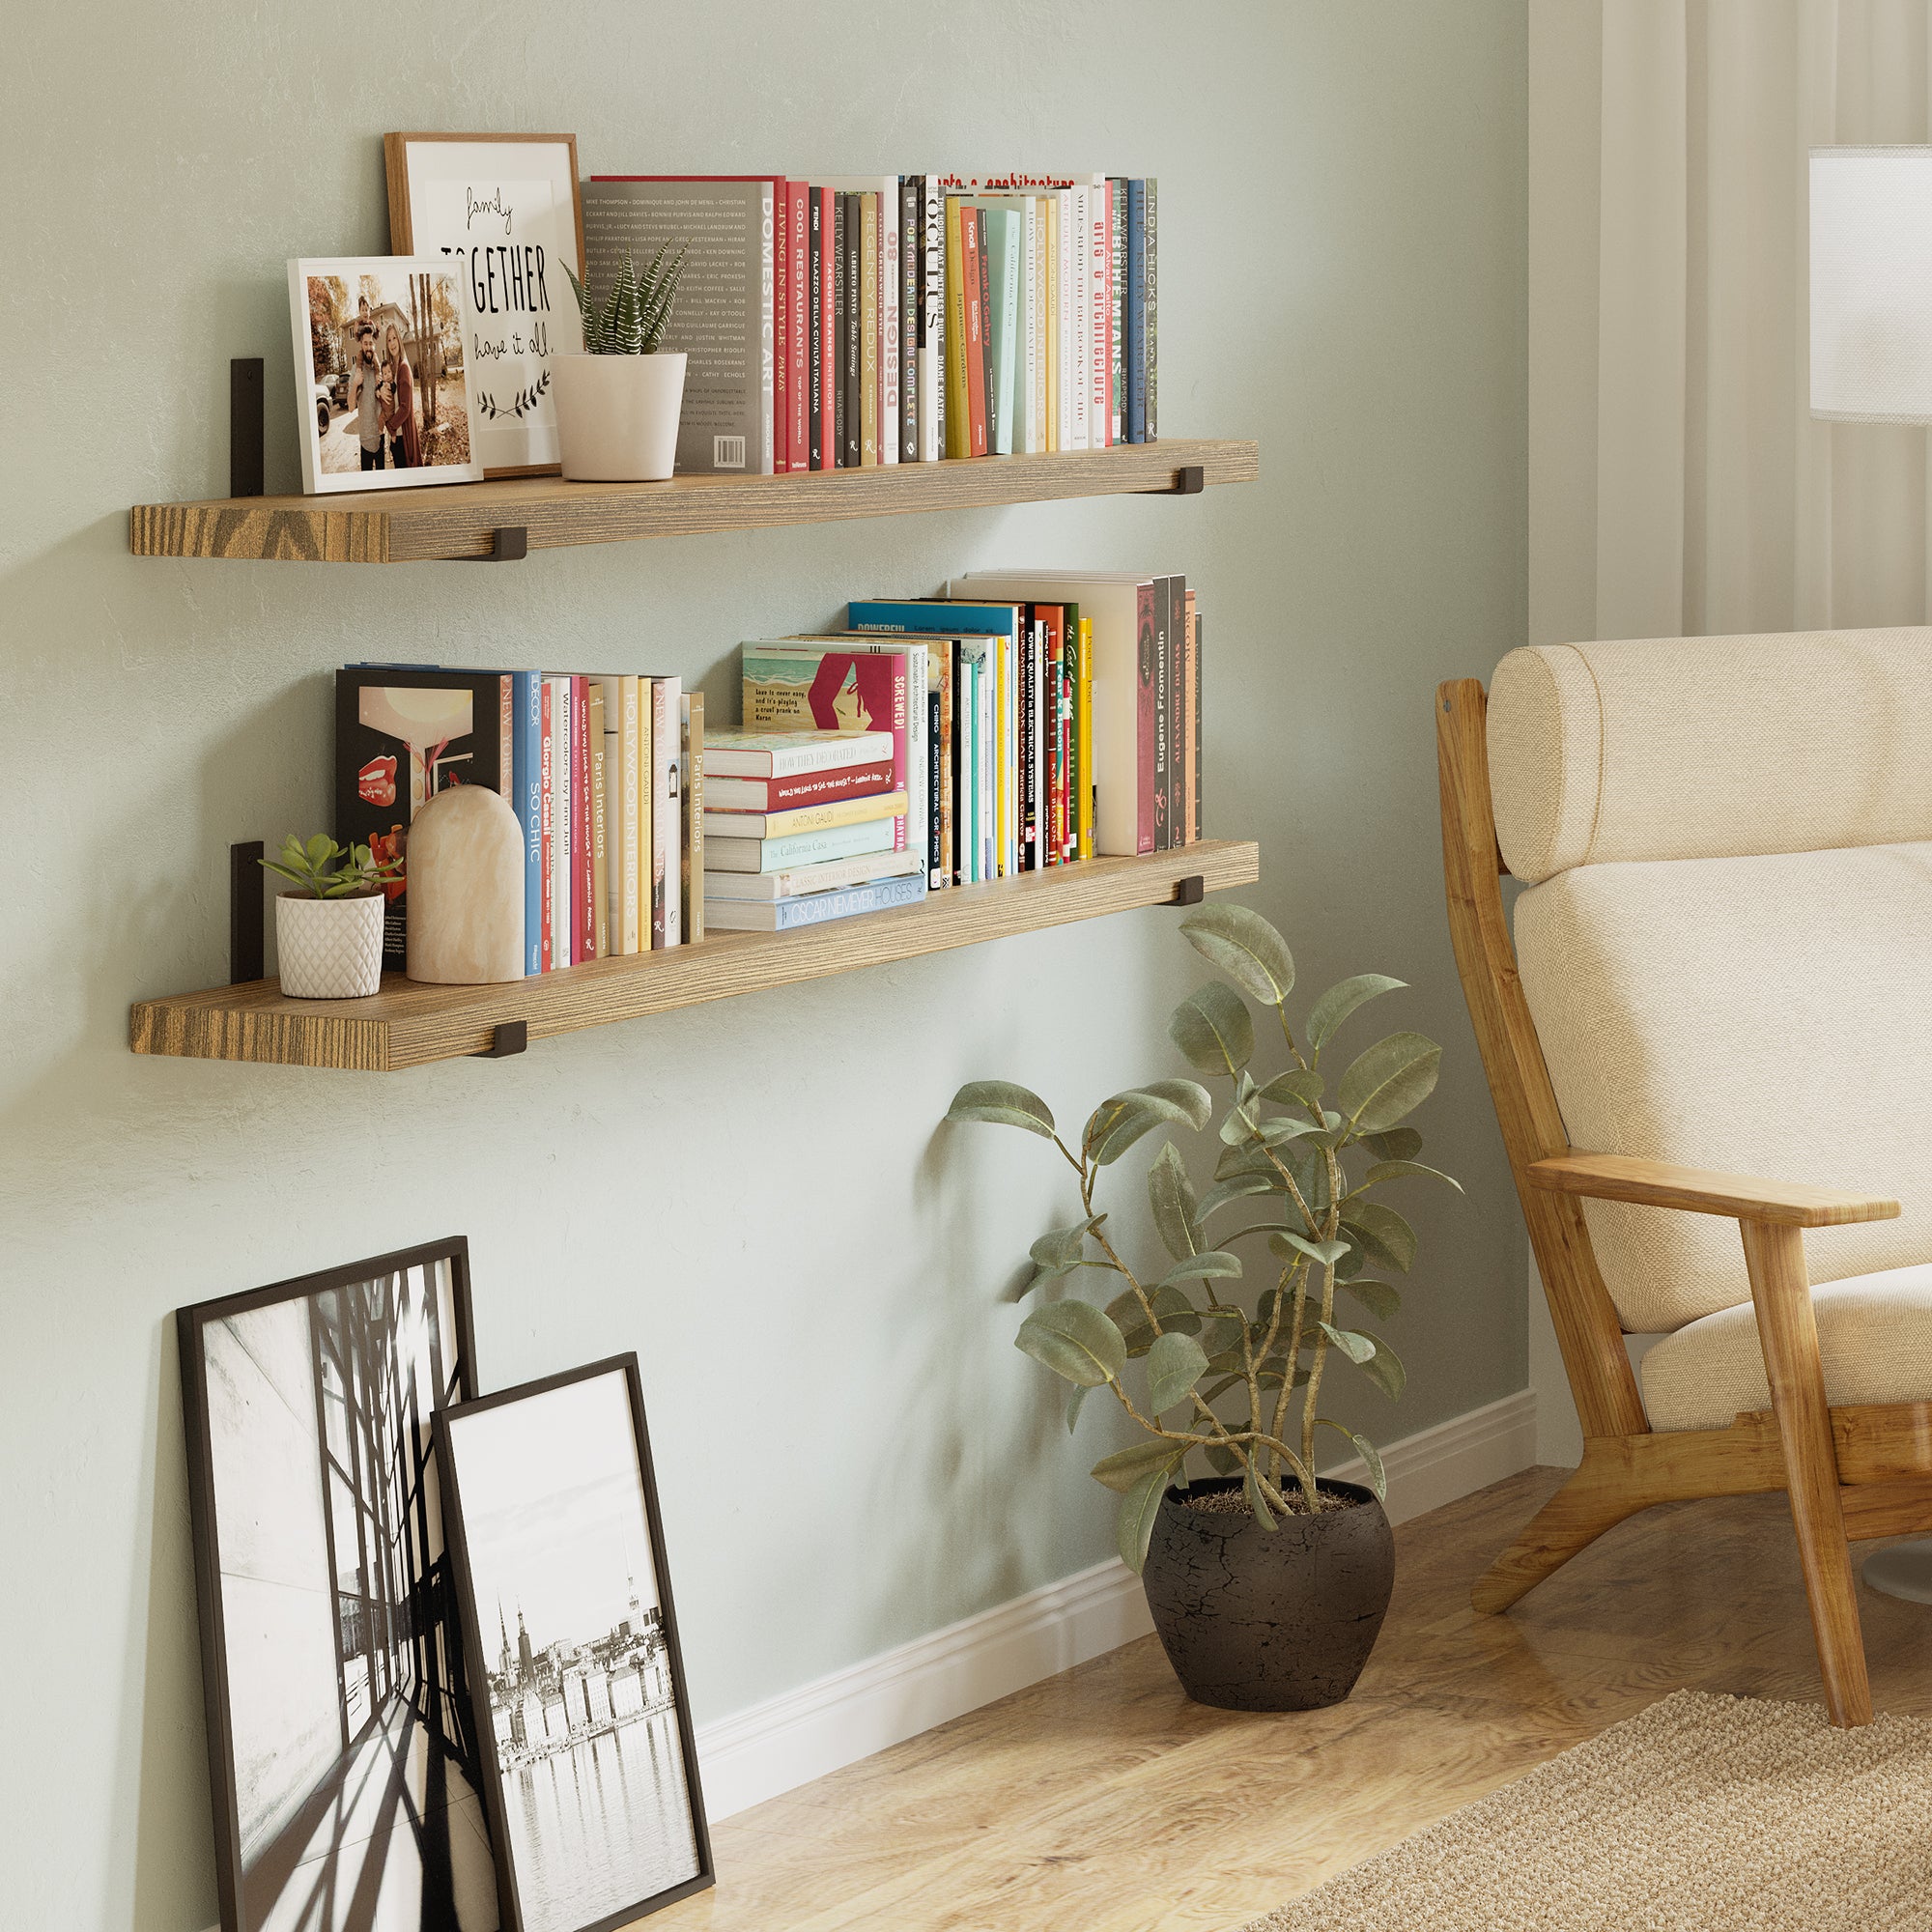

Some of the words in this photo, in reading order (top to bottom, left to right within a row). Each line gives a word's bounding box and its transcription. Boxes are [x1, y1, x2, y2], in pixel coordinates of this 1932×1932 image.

[467, 186, 514, 235] family
[867, 211, 875, 302] REGENCY
[888, 232, 897, 261] 80
[927, 199, 938, 328] OCULUS
[1094, 222, 1104, 257] arts
[440, 244, 551, 312] GETHER
[762, 198, 773, 338] DOMESTIC
[778, 269, 786, 286] IN
[1112, 236, 1121, 375] BOHEMIANS
[473, 333, 508, 360] have
[513, 328, 525, 356] it
[867, 308, 875, 371] REDUX
[888, 305, 897, 407] DESIGN
[1094, 293, 1104, 404] architecture
[762, 348, 773, 396] ART
[798, 392, 802, 401] OF
[656, 695, 664, 727] NEW
[542, 736, 551, 789] Giorgio
[595, 752, 603, 790] Paris
[626, 694, 636, 815] HOLLYWOOD
[656, 735, 664, 773] YORK
[694, 755, 703, 789] Paris
[531, 782, 539, 811] SO
[562, 780, 569, 794] by
[542, 793, 551, 835] Casali
[596, 794, 605, 858] Interiors
[656, 781, 664, 876] APARTMENTS
[694, 794, 703, 852] Interiors
[531, 815, 539, 863] CHIC
[780, 843, 811, 856] California
[812, 839, 827, 850] Casa
[626, 822, 636, 918] INTERIORS
[791, 900, 828, 923] OSCAR
[875, 882, 912, 906] HOUSES
